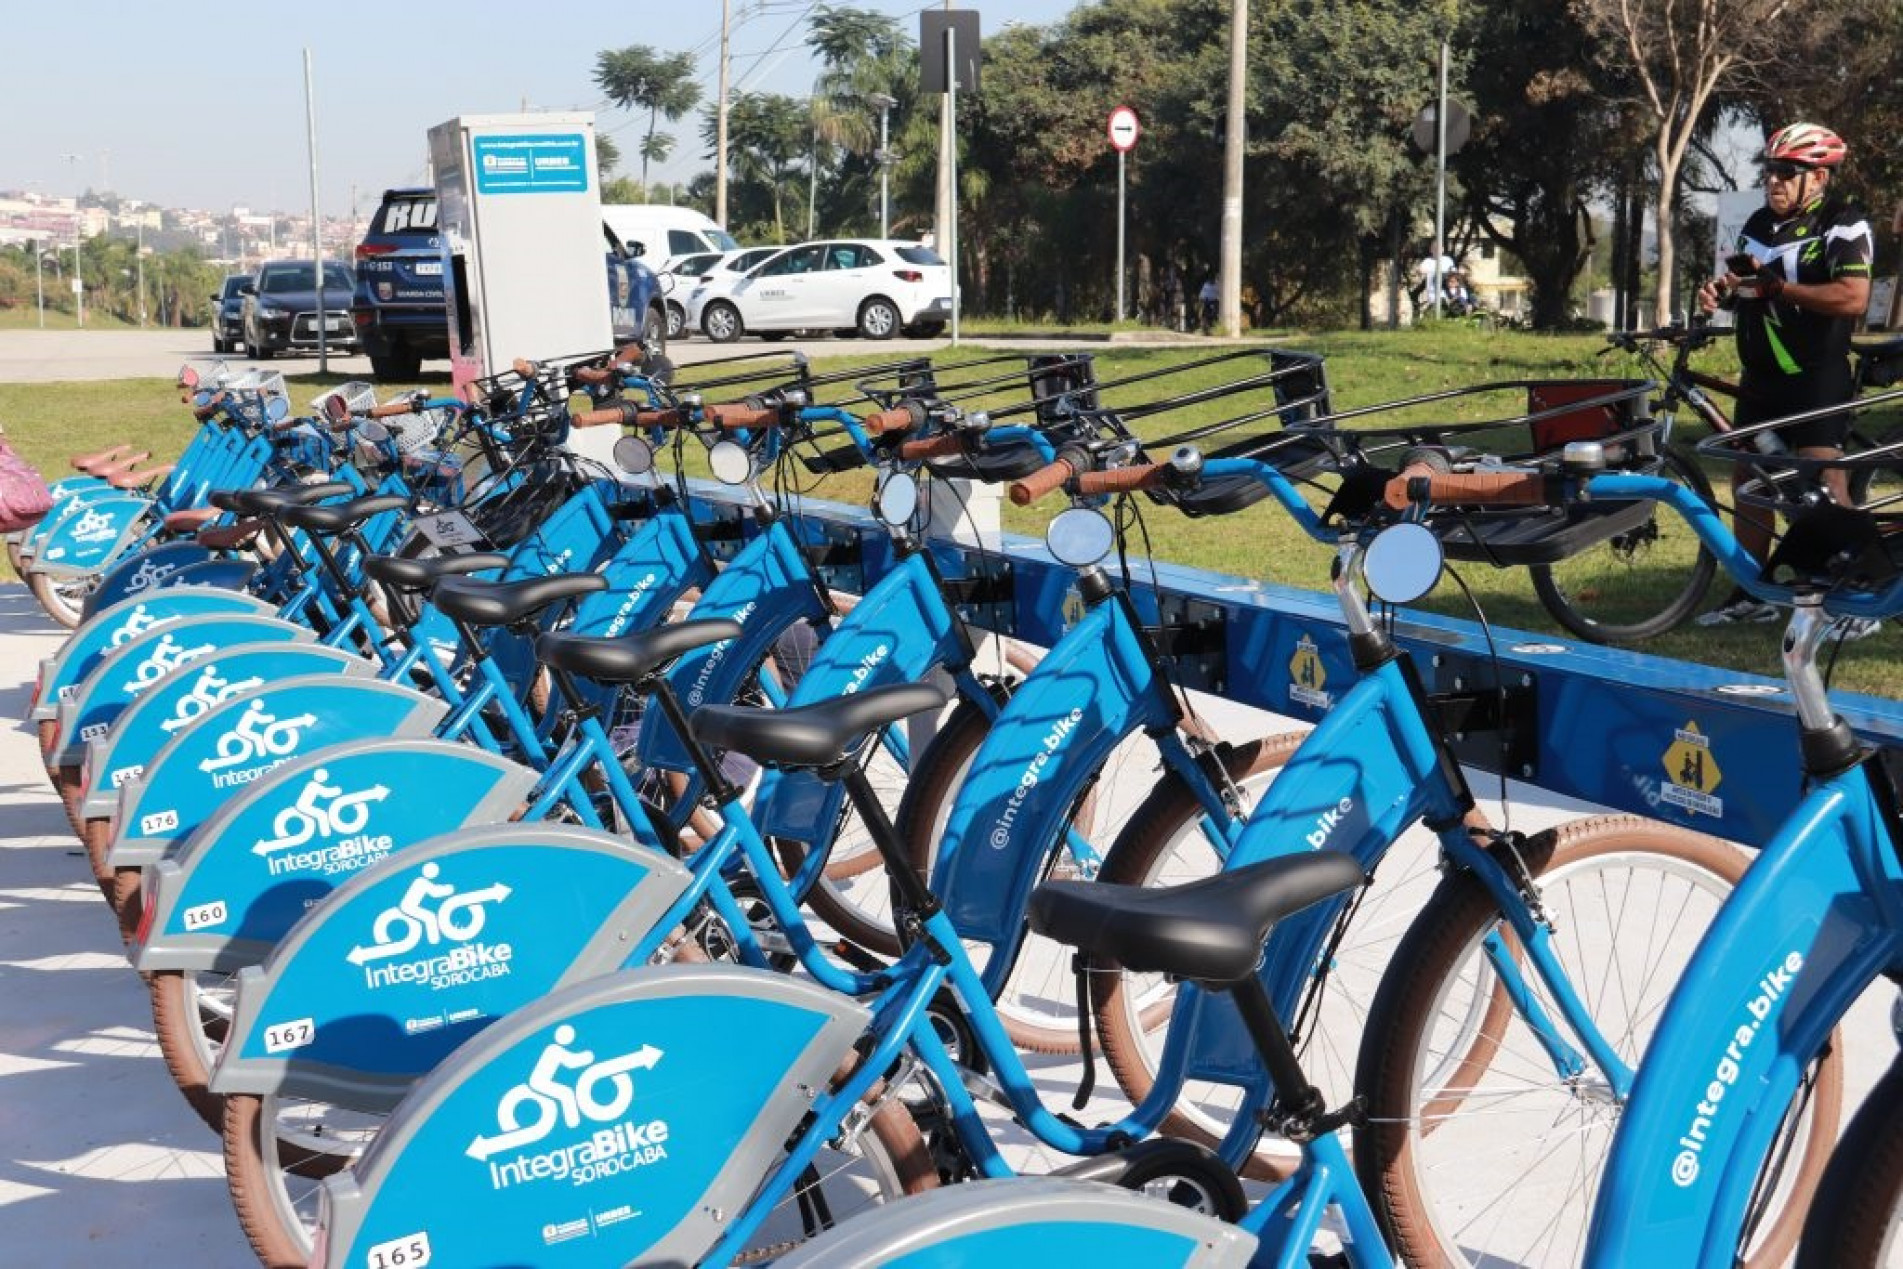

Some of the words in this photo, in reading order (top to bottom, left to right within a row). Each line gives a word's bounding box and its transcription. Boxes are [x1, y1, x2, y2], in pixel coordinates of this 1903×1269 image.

[990, 707, 1083, 850] @integra.bike
[144, 814, 174, 831] 176
[268, 835, 393, 876] IntegraBike
[187, 906, 223, 926] 160
[366, 942, 513, 989] IntegraBike
[431, 963, 511, 991] SOROCABA
[269, 1025, 309, 1047] 167
[1671, 951, 1803, 1188] @integra.bike
[490, 1119, 669, 1190] IntegraBike
[571, 1145, 668, 1187] SOROCABA
[373, 1240, 424, 1269] 165
